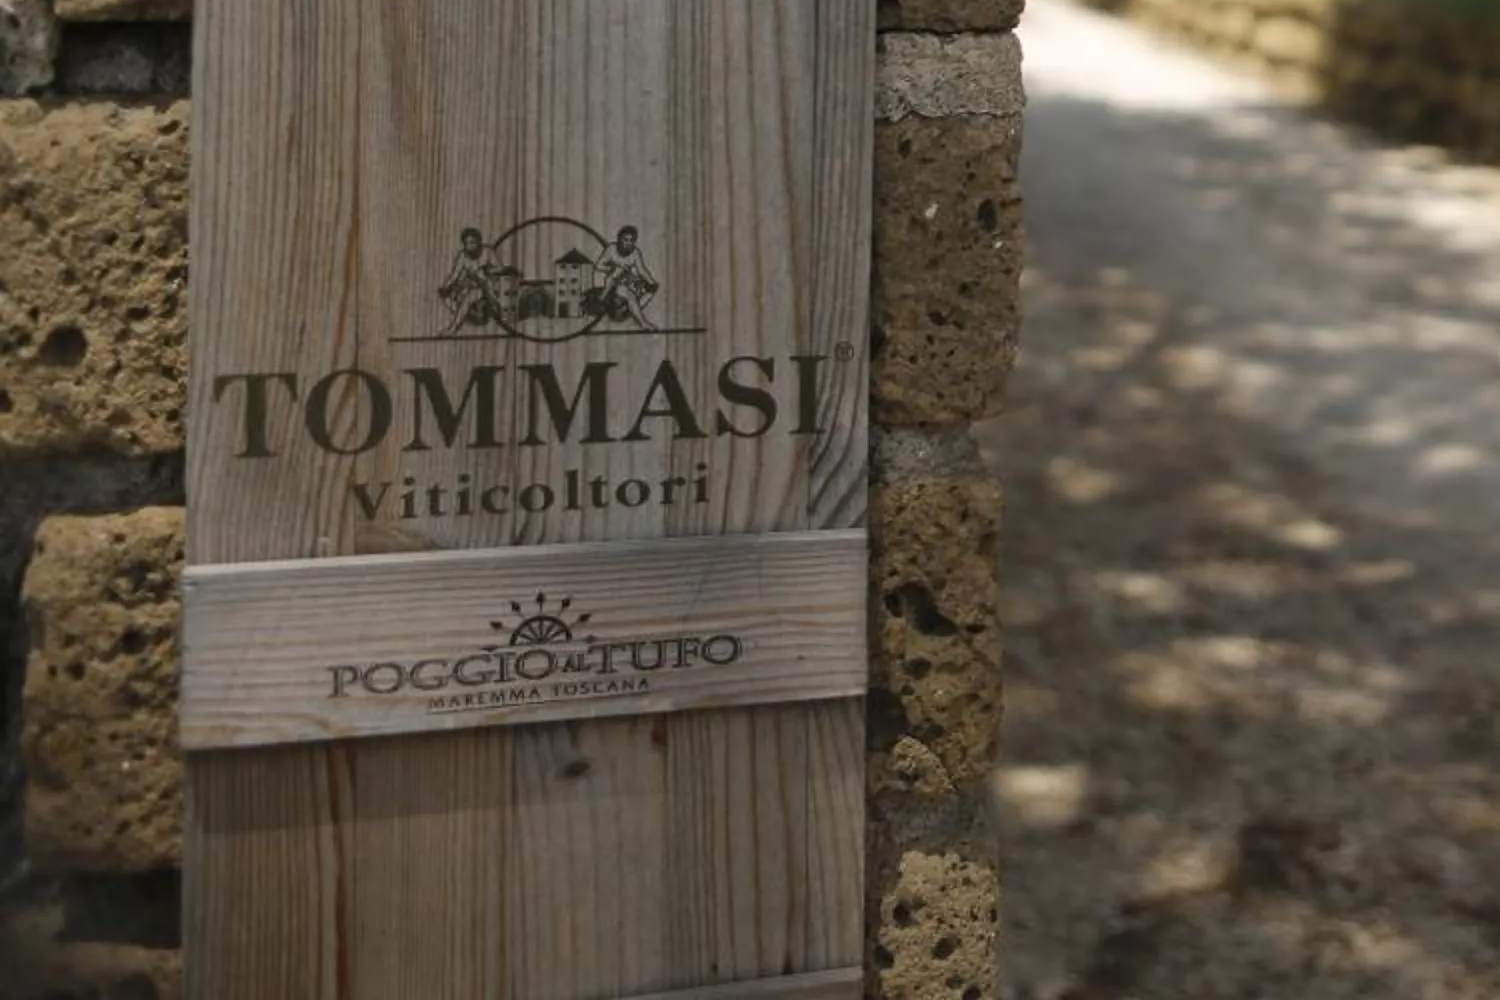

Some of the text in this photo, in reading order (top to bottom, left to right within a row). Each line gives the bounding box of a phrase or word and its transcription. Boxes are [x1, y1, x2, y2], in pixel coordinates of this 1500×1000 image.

[351, 462, 711, 521] Viticoltori
[327, 647, 557, 699] POGGIO
[588, 634, 743, 675] TUFO
[427, 677, 650, 710] MAREMMA TOSCANA
